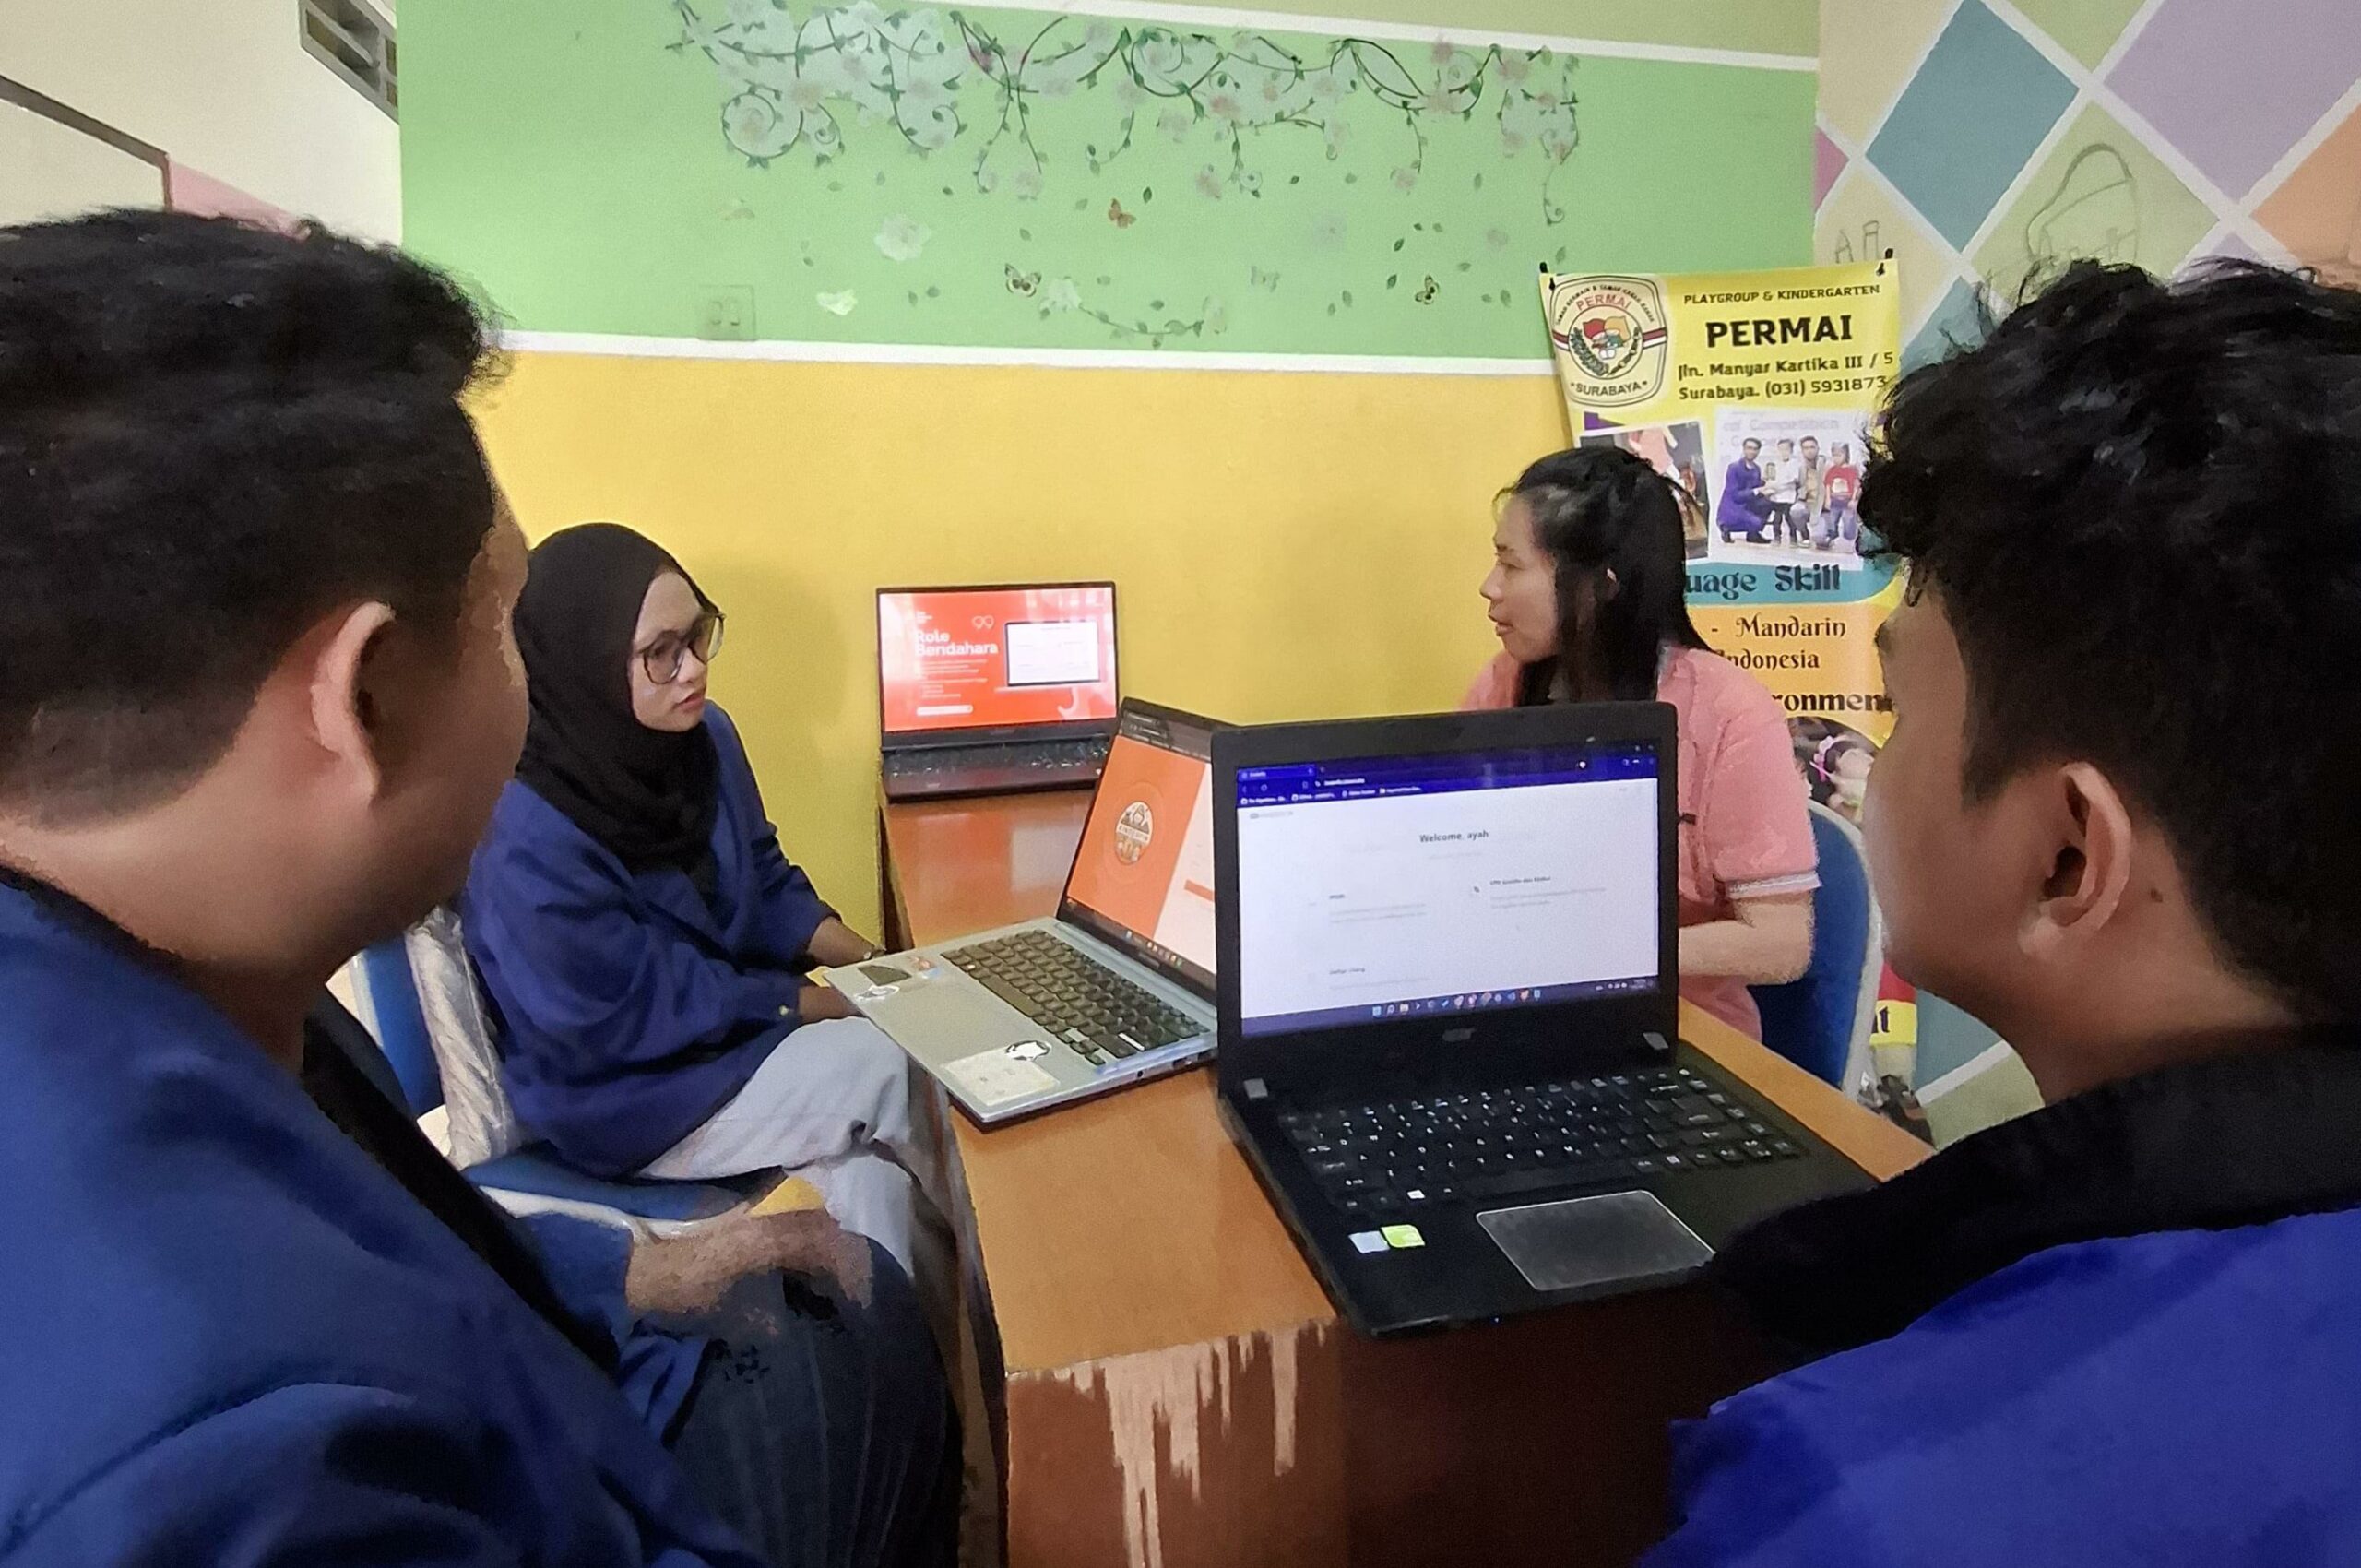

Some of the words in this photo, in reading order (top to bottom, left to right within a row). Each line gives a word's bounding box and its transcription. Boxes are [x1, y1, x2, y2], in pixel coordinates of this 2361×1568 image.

[1576, 293, 1632, 311] PERMAI
[1684, 291, 1760, 304] PLAYGROUP
[1762, 291, 1774, 301] &
[1777, 284, 1880, 301] KINDERGARTEN
[1705, 315, 1853, 348] PERMAI
[1678, 363, 1704, 381] Jln.
[1709, 362, 1771, 377] Manyar
[1775, 356, 1839, 373] Kartika
[1845, 355, 1863, 369] III
[1869, 352, 1879, 369] /
[1883, 351, 1893, 365] 5
[1575, 380, 1642, 397] SURABAYA
[1679, 385, 1760, 400] Surabaya.
[1765, 379, 1806, 398] (031)
[1810, 374, 1887, 393] 5931873
[1686, 572, 1758, 600] uage
[1774, 564, 1841, 592] Skill
[1735, 612, 1846, 638] Mandarin
[916, 641, 999, 656] Bendahara
[1772, 693, 1892, 712] onmen
[1466, 829, 1489, 841] ayah
